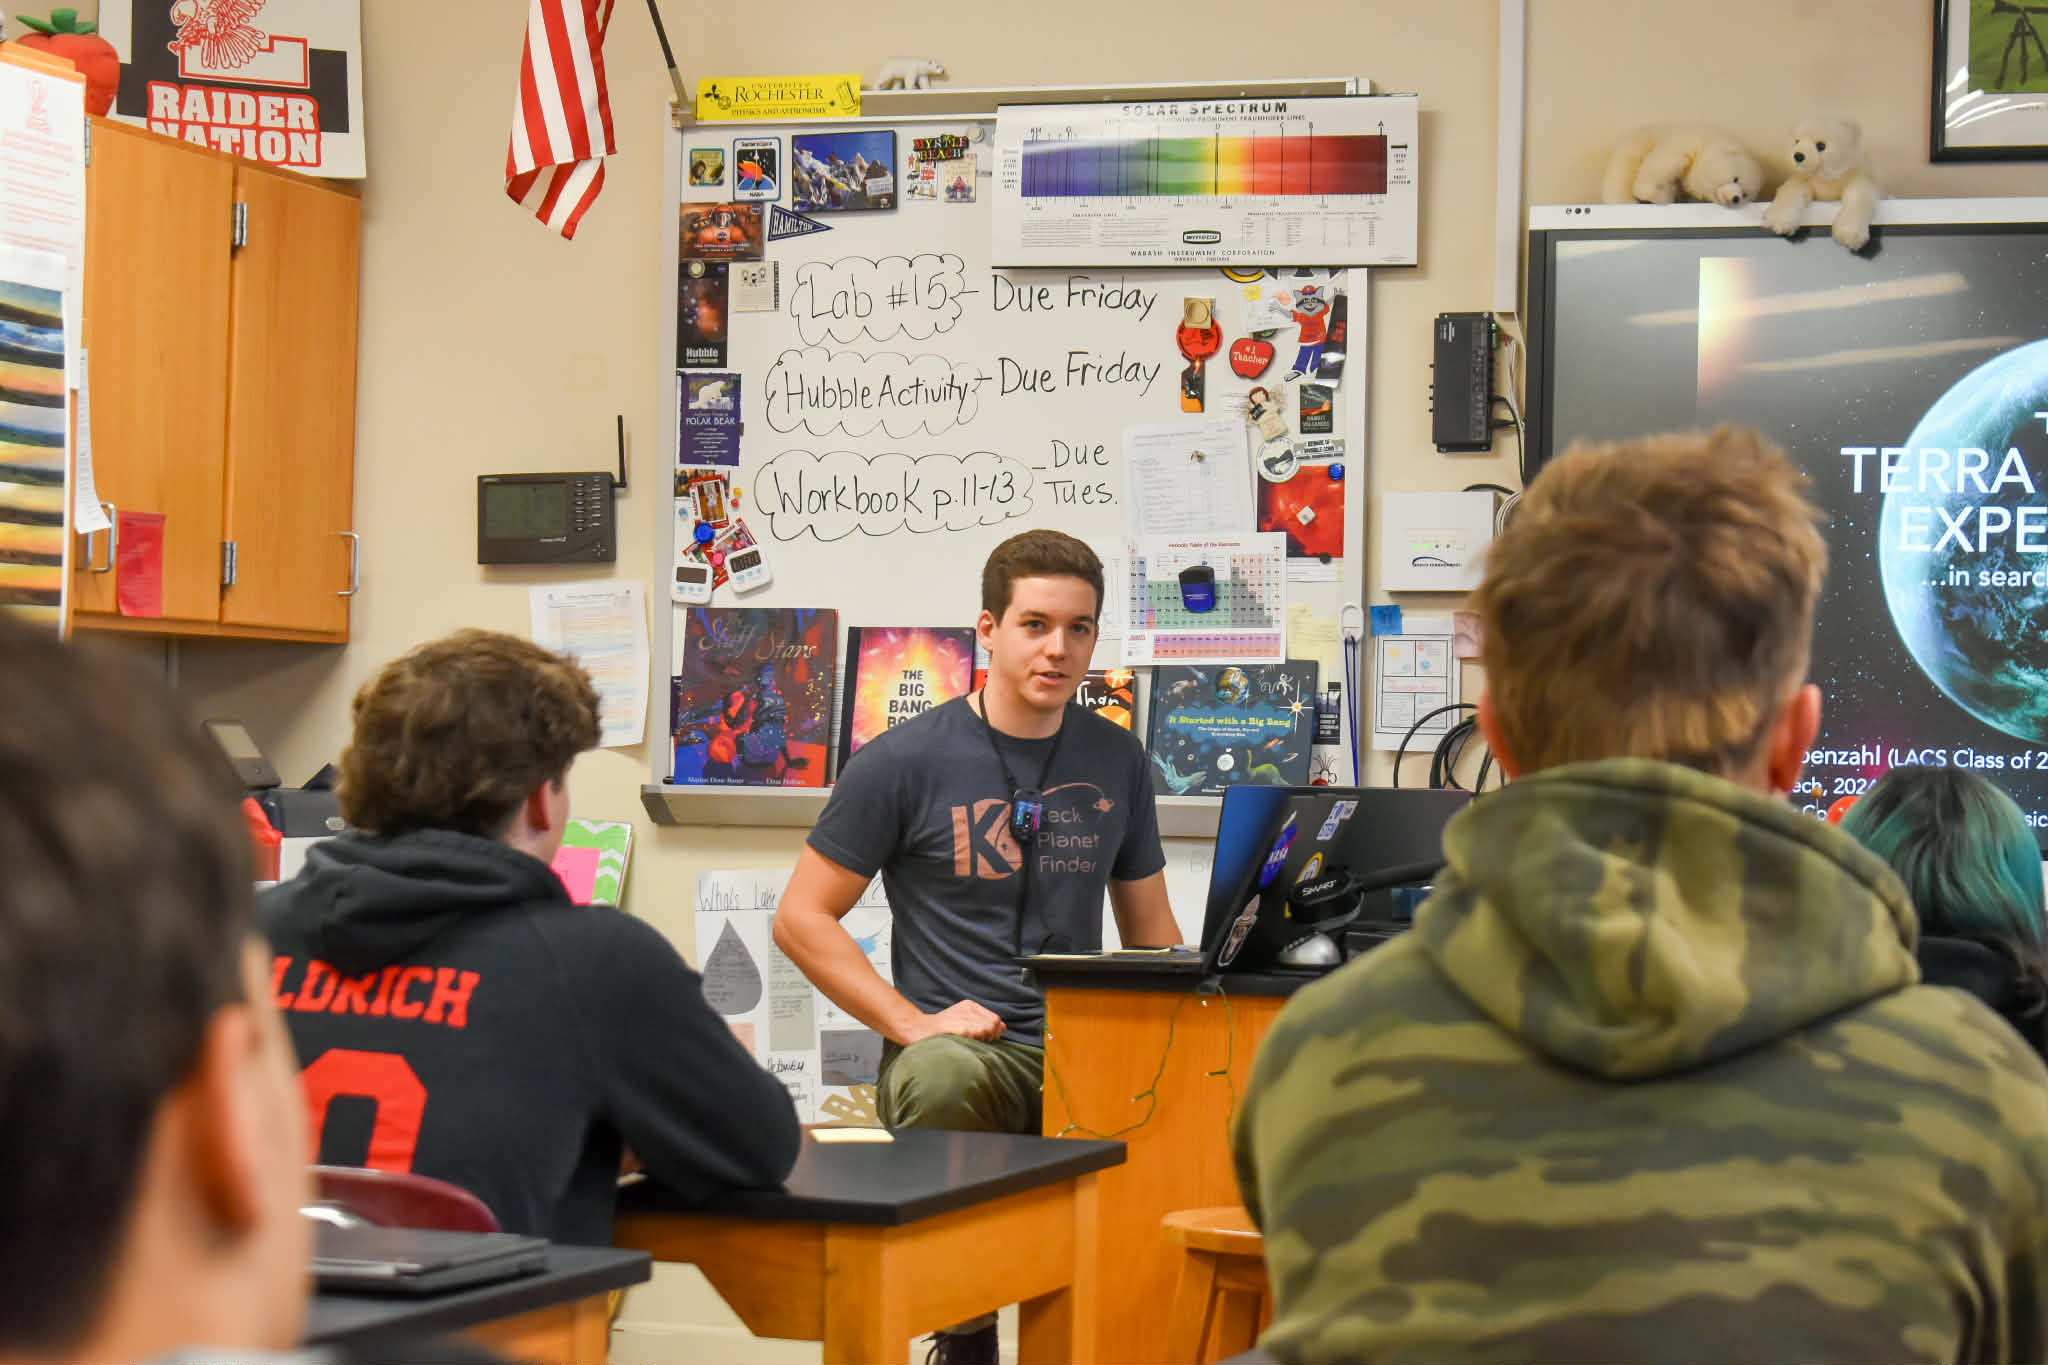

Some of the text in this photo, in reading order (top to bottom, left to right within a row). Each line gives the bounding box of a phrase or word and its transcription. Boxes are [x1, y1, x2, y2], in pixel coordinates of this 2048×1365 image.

[735, 86, 824, 102] ROCHESTER
[148, 81, 318, 130] RAIDER
[731, 107, 827, 117] PHYSICS AND ASTRONOMY
[1122, 102, 1288, 117] SOLAR SPECTRUM
[914, 135, 966, 151] MYRTLE
[921, 148, 961, 160] BEACH
[773, 211, 814, 236] HAMILTON
[810, 272, 1159, 322] Lab #15 Due Friday
[687, 347, 719, 358] Hubble
[1232, 352, 1268, 365] Teacher
[785, 351, 1161, 414] Hubble Activity Due Friday
[686, 417, 736, 425] POLAR BEAR
[1051, 440, 1110, 468] Due
[1840, 447, 2036, 494] TERRA
[1044, 480, 1119, 506] Tues.
[1901, 506, 2048, 553] EXPE
[1978, 566, 2048, 588] searc
[755, 631, 817, 661] Stars
[902, 670, 924, 680] THE
[899, 683, 924, 697] BIG
[1169, 715, 1177, 724] It
[1179, 716, 1215, 725] Started
[1216, 716, 1239, 725] with
[1249, 717, 1265, 728] Big
[1266, 718, 1292, 729] Bang
[1888, 748, 1948, 768] (LACS
[1953, 749, 2005, 769] Class
[2010, 750, 2032, 769] of
[1038, 832, 1099, 849] Planet
[1039, 856, 1097, 873] Finder
[1302, 880, 1336, 897] SMART
